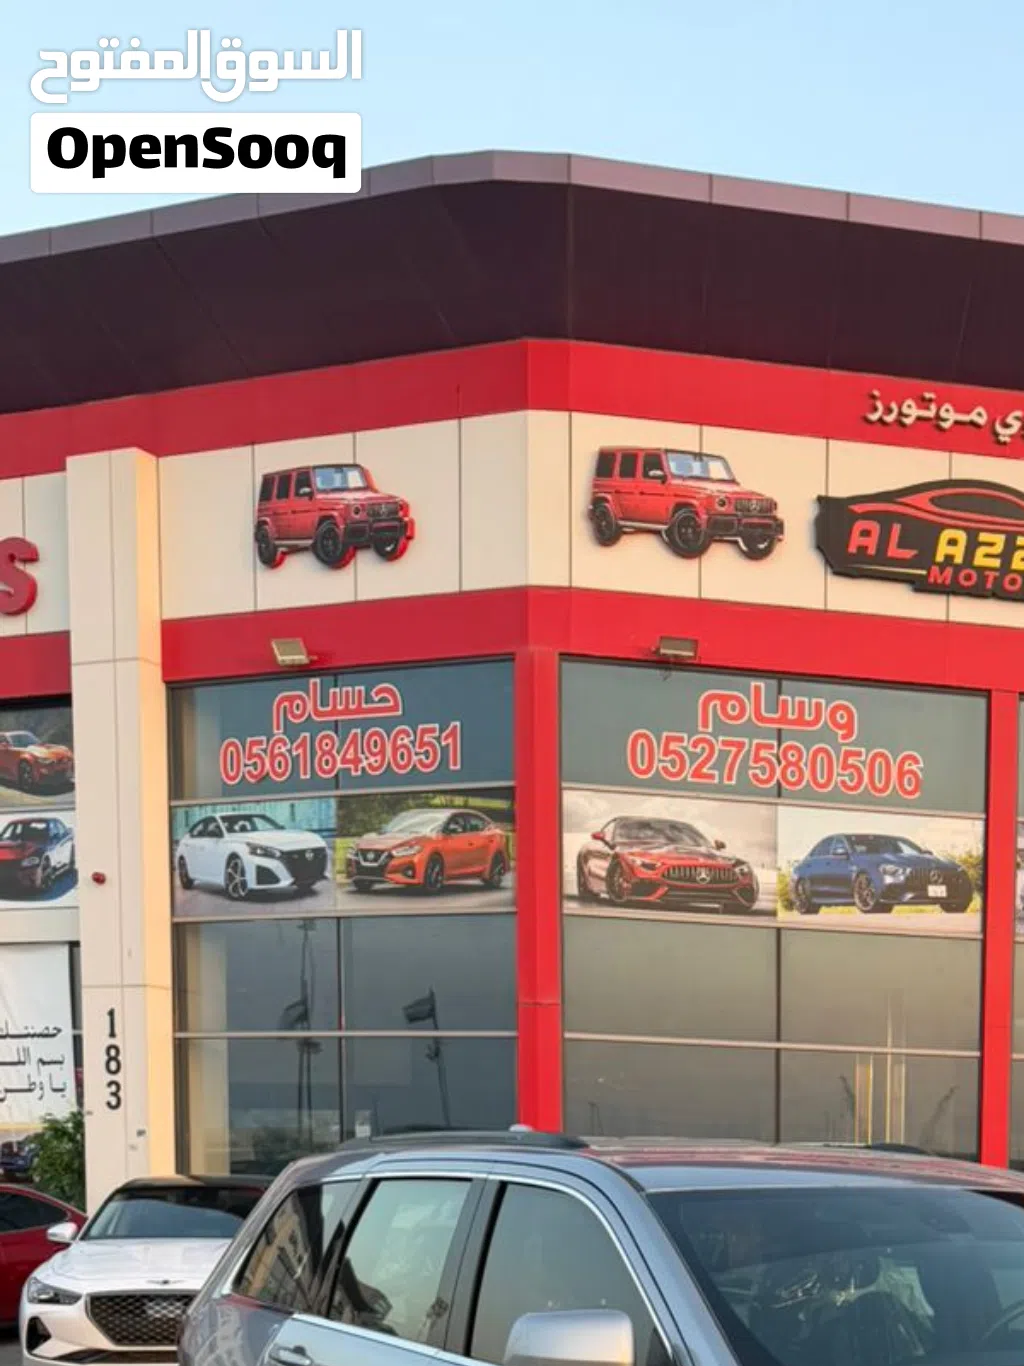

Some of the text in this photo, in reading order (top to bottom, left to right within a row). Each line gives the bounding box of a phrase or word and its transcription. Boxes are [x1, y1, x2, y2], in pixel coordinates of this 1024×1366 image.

[863, 390, 988, 429] موتورز
[847, 519, 918, 560] AL
[273, 678, 402, 734] حسام
[698, 681, 857, 742] وسام
[220, 721, 461, 785] 0561849651
[627, 729, 923, 799] 0527580506
